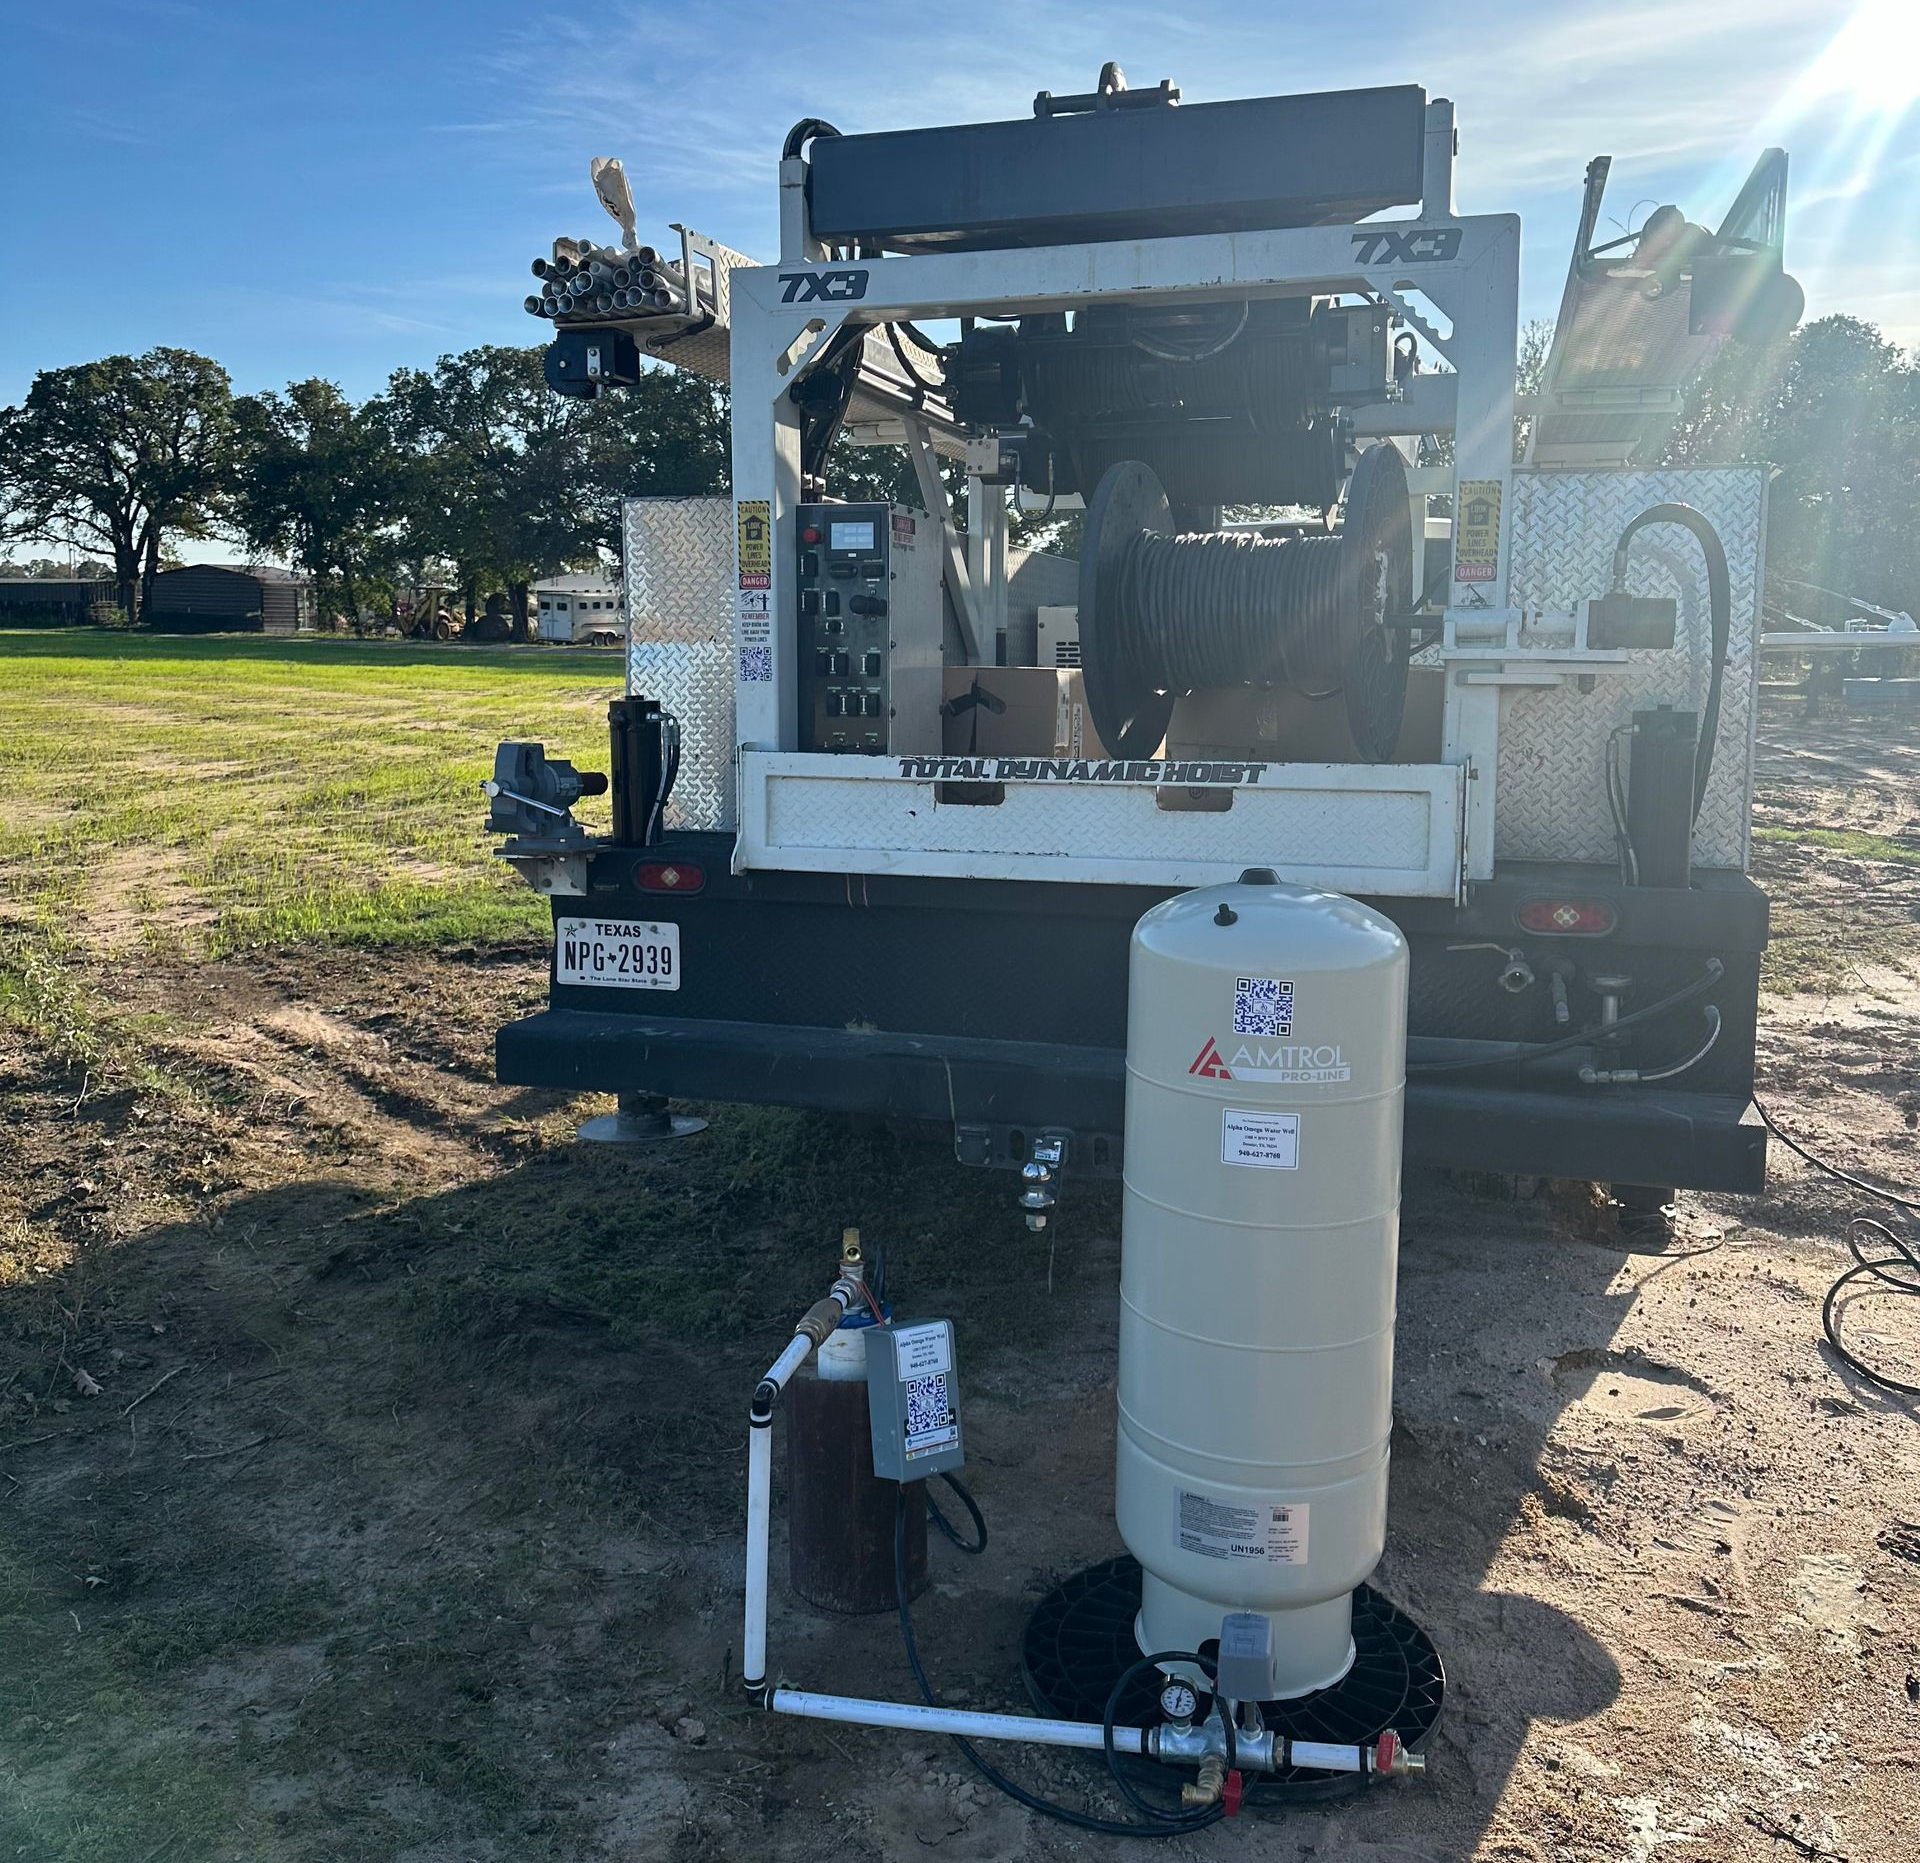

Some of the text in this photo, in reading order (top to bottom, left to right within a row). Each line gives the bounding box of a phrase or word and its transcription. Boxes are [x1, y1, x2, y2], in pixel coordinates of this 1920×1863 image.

[1351, 228, 1463, 265] 7X3
[778, 269, 869, 304] 7X3
[1463, 486, 1496, 496] CAUTION
[741, 504, 767, 513] CAUTION
[1471, 504, 1487, 513] LOOK
[747, 521, 761, 530] LOOK
[1466, 529, 1488, 538] POWER
[745, 543, 763, 551] POWER
[1468, 539, 1486, 547] LINES
[747, 551, 761, 560] LINES
[1459, 548, 1494, 558] OVERHEAD
[741, 560, 768, 568] OVERHEAD
[1459, 567, 1493, 577] DANGER
[742, 576, 768, 586] DANGER
[741, 612, 770, 620] REMEMBER
[899, 757, 1268, 784] TOTAL DYNAMIC HOIST
[595, 923, 641, 938] TEXAS
[565, 940, 672, 975] NPG 2939
[1230, 1044, 1347, 1068] AMTROL
[1281, 1070, 1345, 1082] PRO-LINE
[1226, 1124, 1243, 1132] Alpha
[1243, 1125, 1263, 1134] Omega
[1230, 1544, 1265, 1555] UN1956
